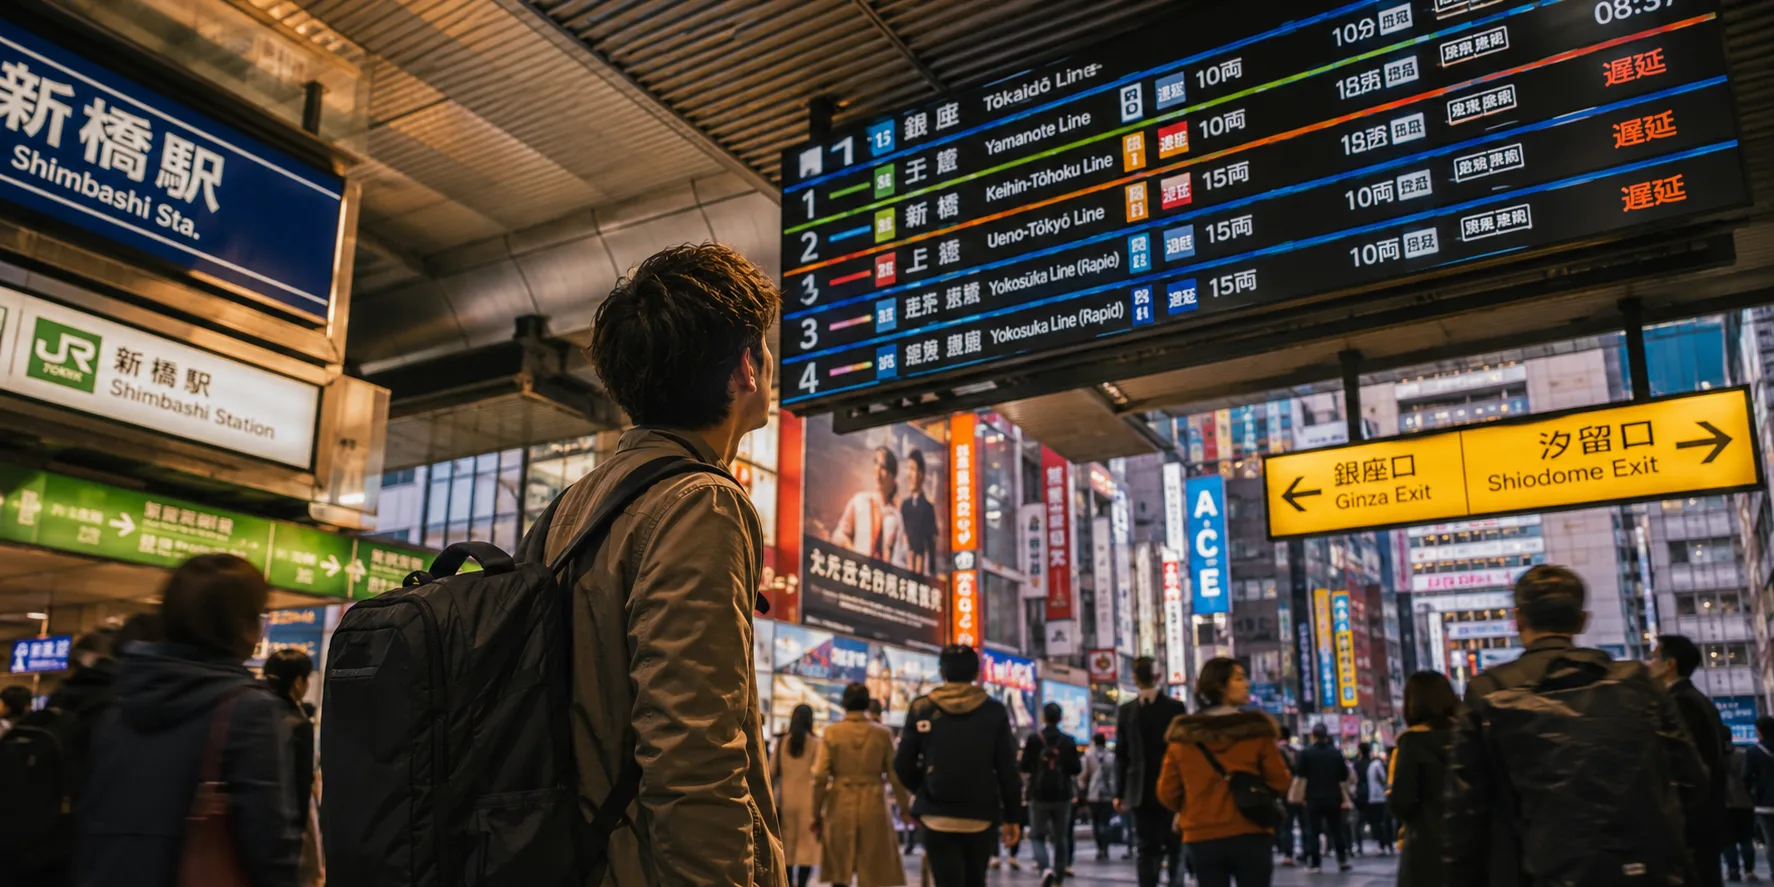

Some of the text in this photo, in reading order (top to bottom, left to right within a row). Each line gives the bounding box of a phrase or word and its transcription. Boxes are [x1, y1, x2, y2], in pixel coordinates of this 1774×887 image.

[1196, 58, 1242, 88] 10両
[1603, 48, 1667, 88] 遅延
[0, 60, 225, 214] 新橋駅
[985, 112, 1091, 156] Yamanote Line
[1199, 108, 1246, 138] 10両
[1612, 110, 1678, 148] 遅延
[1083, 154, 1113, 174] Line
[1202, 161, 1250, 191] 15両
[11, 145, 200, 240] Shimbashi Sta.
[802, 189, 814, 219] 1
[1345, 180, 1394, 210] 10両
[1621, 174, 1686, 212] 遅延
[1074, 207, 1105, 226] Line
[1206, 214, 1252, 244] 15両
[800, 232, 818, 263] 2
[1350, 237, 1399, 268] 10両
[1050, 264, 1075, 282] Line
[1209, 269, 1257, 298] 15両
[800, 318, 818, 350] 3
[990, 320, 1049, 344] Yokosuka
[1051, 312, 1076, 331] Line
[1078, 301, 1124, 326] (Rapid)
[35, 332, 96, 374] JR
[113, 346, 212, 398] 新橋駅
[798, 362, 819, 394] 4
[110, 380, 275, 440] Shimbashi Station
[1538, 420, 1654, 462] 汐留口
[1334, 454, 1416, 487] 銀座口
[1487, 456, 1659, 493] Shiodome Exit
[1336, 484, 1432, 511] Ginza Exit
